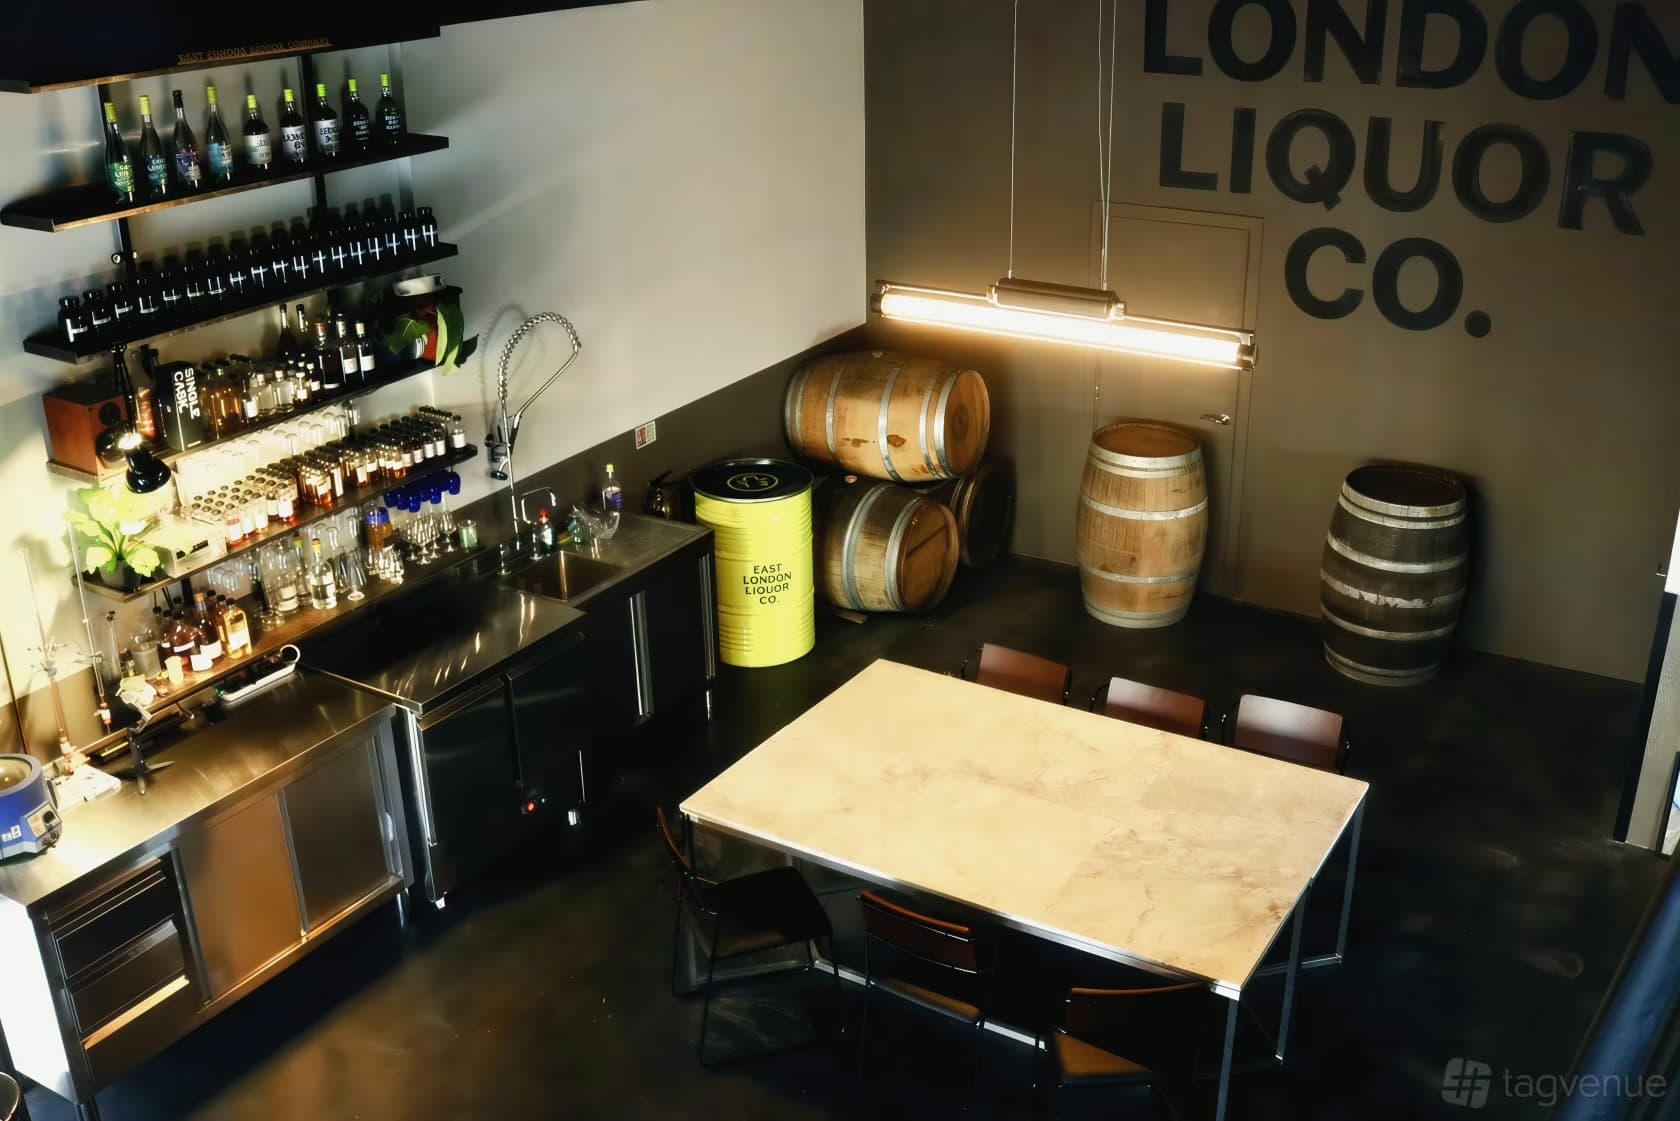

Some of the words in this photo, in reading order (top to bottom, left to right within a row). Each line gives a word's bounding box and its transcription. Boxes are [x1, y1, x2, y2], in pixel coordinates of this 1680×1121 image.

[1144, 0, 1680, 103] LONDON
[1160, 102, 1653, 236] LIQUOR
[1284, 227, 1492, 338] CO.
[174, 371, 189, 414] CASK
[184, 367, 201, 420] SINGLE
[743, 571, 792, 585] LONDON
[753, 563, 782, 574] EAST
